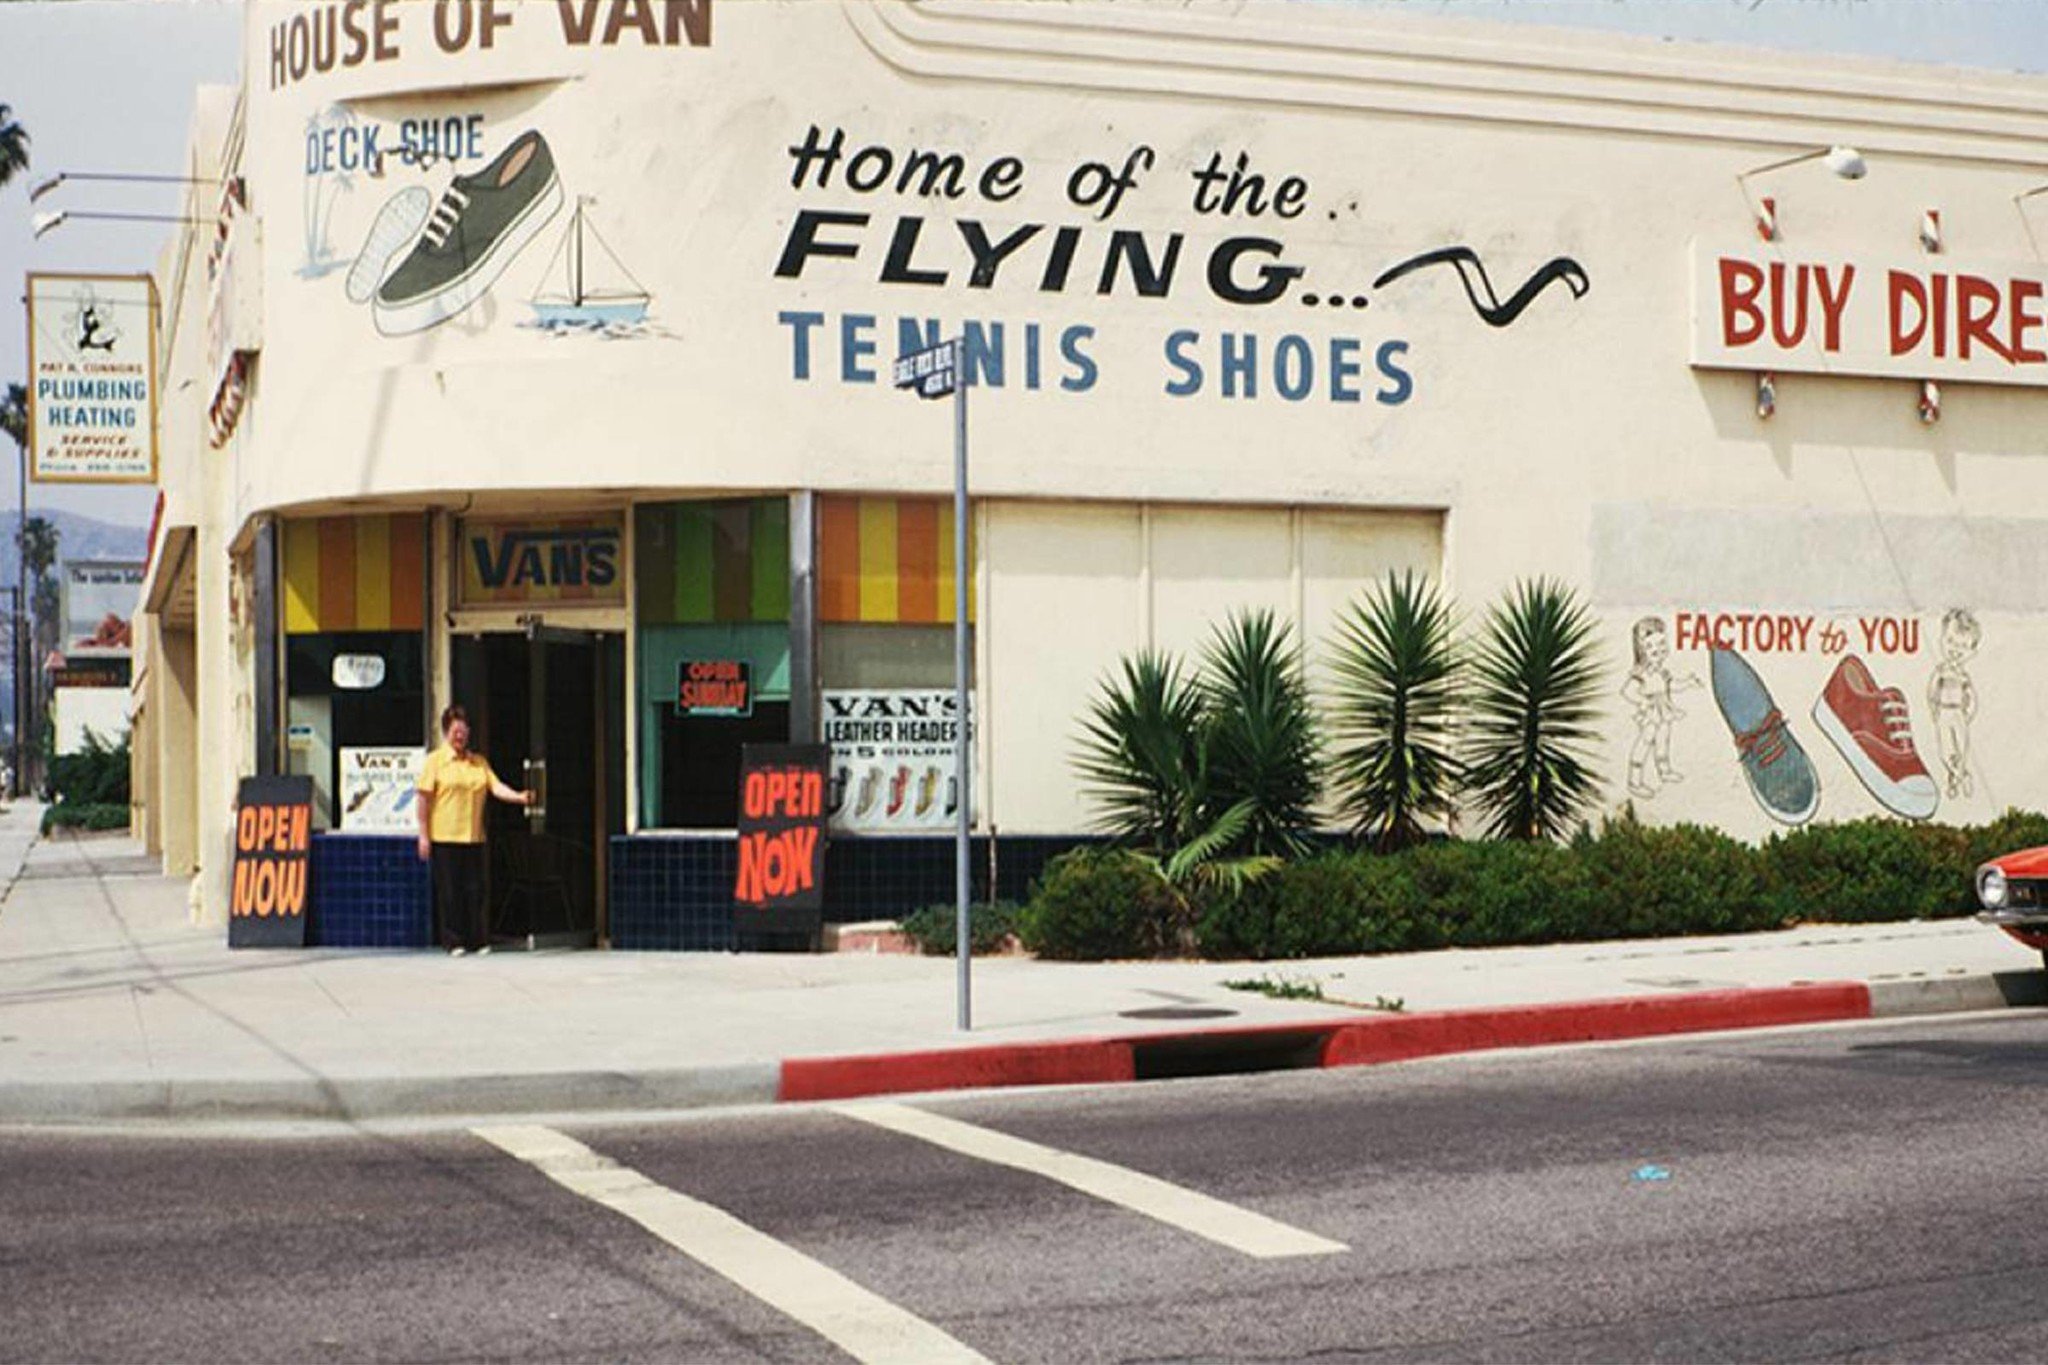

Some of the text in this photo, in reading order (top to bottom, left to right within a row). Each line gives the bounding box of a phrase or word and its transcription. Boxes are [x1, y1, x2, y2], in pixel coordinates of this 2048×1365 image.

[270, 0, 400, 90] HOUSE
[434, 0, 513, 53] OF
[305, 114, 485, 176] DECK SHOE
[788, 124, 1309, 219] Home of the
[1718, 257, 2048, 366] BUY DIRE
[779, 312, 1415, 405] TENNIS SHOES
[38, 379, 147, 401] PLUMBING
[48, 407, 136, 427] HEATING
[61, 435, 128, 445] SERVICE
[65, 448, 142, 459] SUPPLIES
[1676, 613, 1920, 654] FACTORY to YOU
[689, 661, 740, 680] OPEN
[680, 681, 747, 708] SUNDAY
[825, 721, 893, 742] LEATHER
[857, 746, 875, 757] 5
[239, 804, 310, 853] OPEN
[735, 827, 818, 901] NOW
[232, 859, 306, 917] NOW
